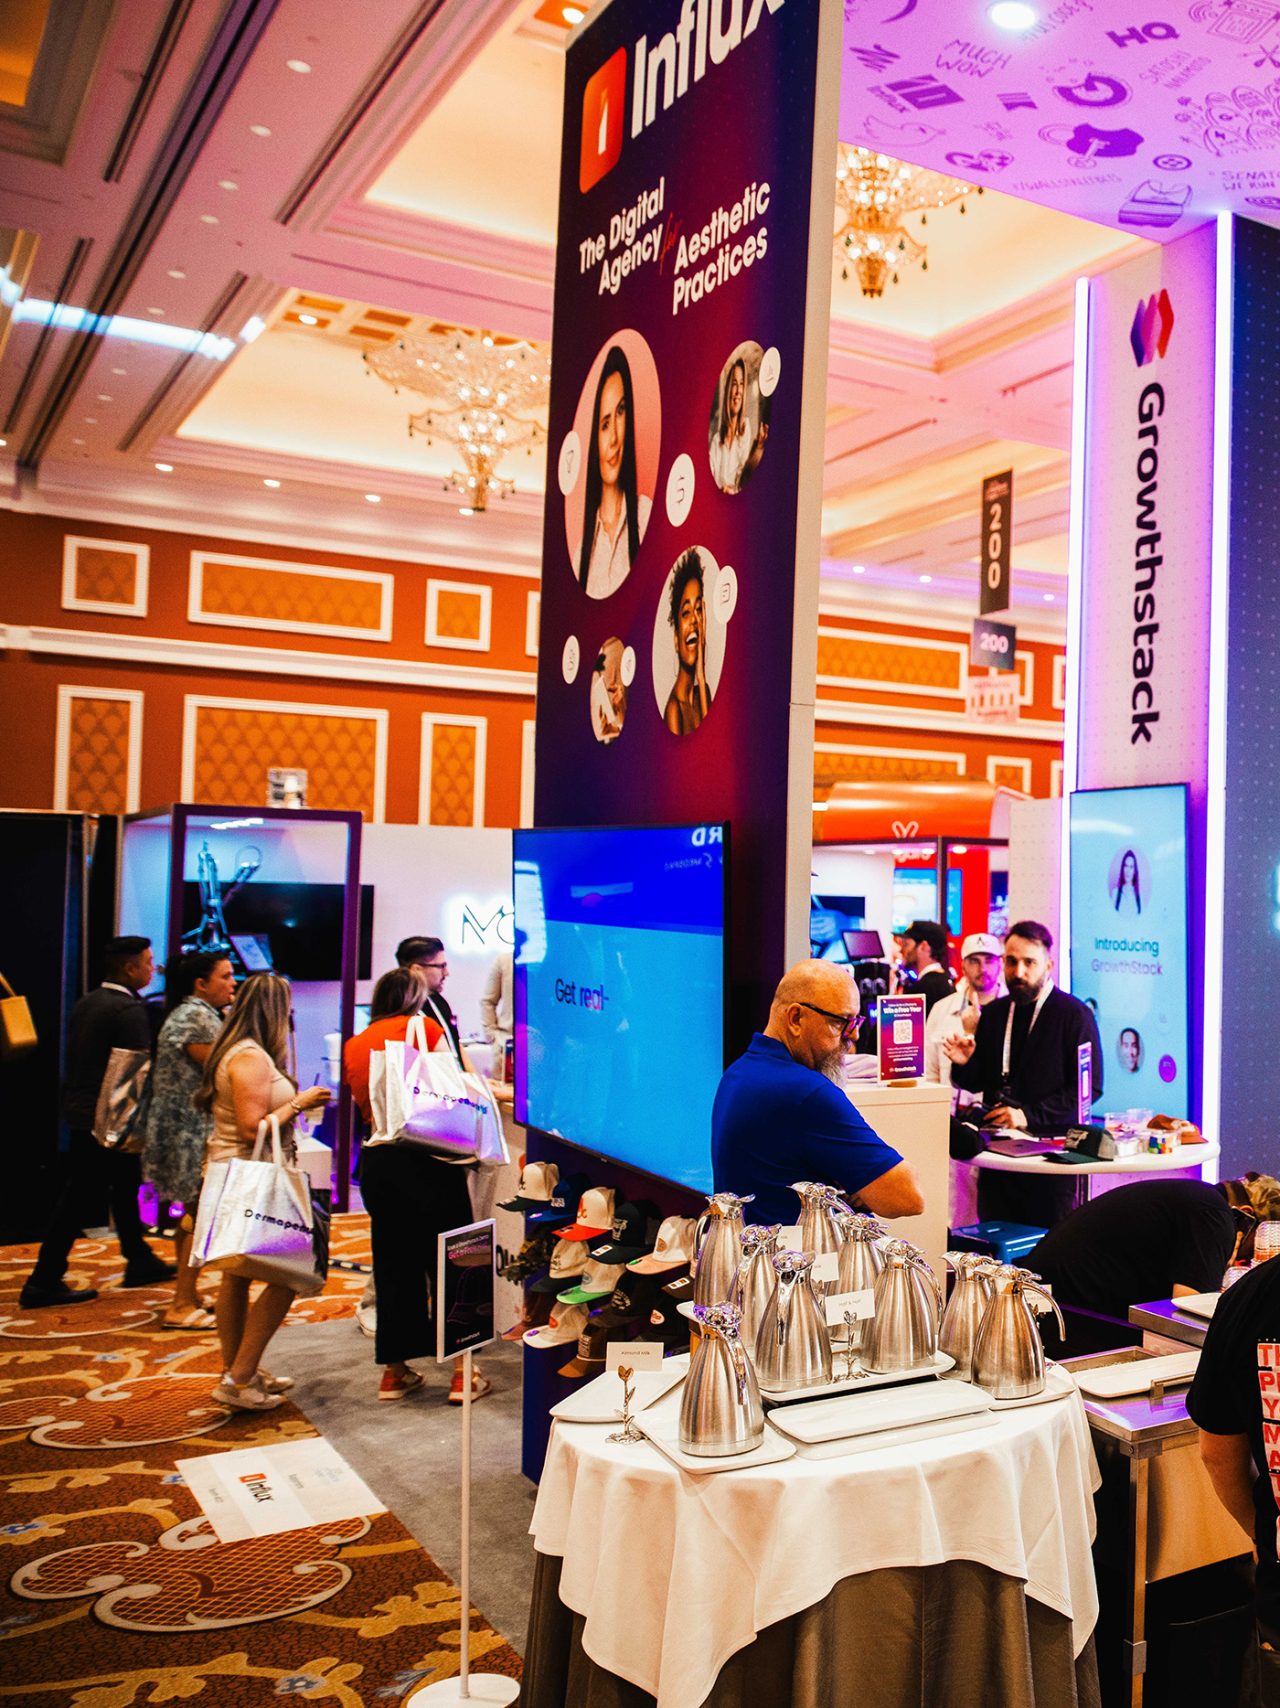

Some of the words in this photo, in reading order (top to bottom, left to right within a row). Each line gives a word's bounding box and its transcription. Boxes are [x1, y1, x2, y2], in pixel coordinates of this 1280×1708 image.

[1106, 21, 1180, 49] HQ
[935, 53, 995, 79] WOW
[943, 38, 1012, 70] MUCH
[579, 234, 606, 274] The
[609, 176, 665, 251] Digital
[674, 182, 771, 275] Aesthetic
[598, 223, 664, 296] Agency
[672, 227, 768, 316] Practices
[987, 502, 1003, 590] 200
[1131, 382, 1166, 746] Growthstack
[980, 632, 1009, 654] 200
[1094, 937, 1160, 958] Introducing
[1091, 958, 1164, 977] GrowthStack
[555, 978, 577, 1006] Get
